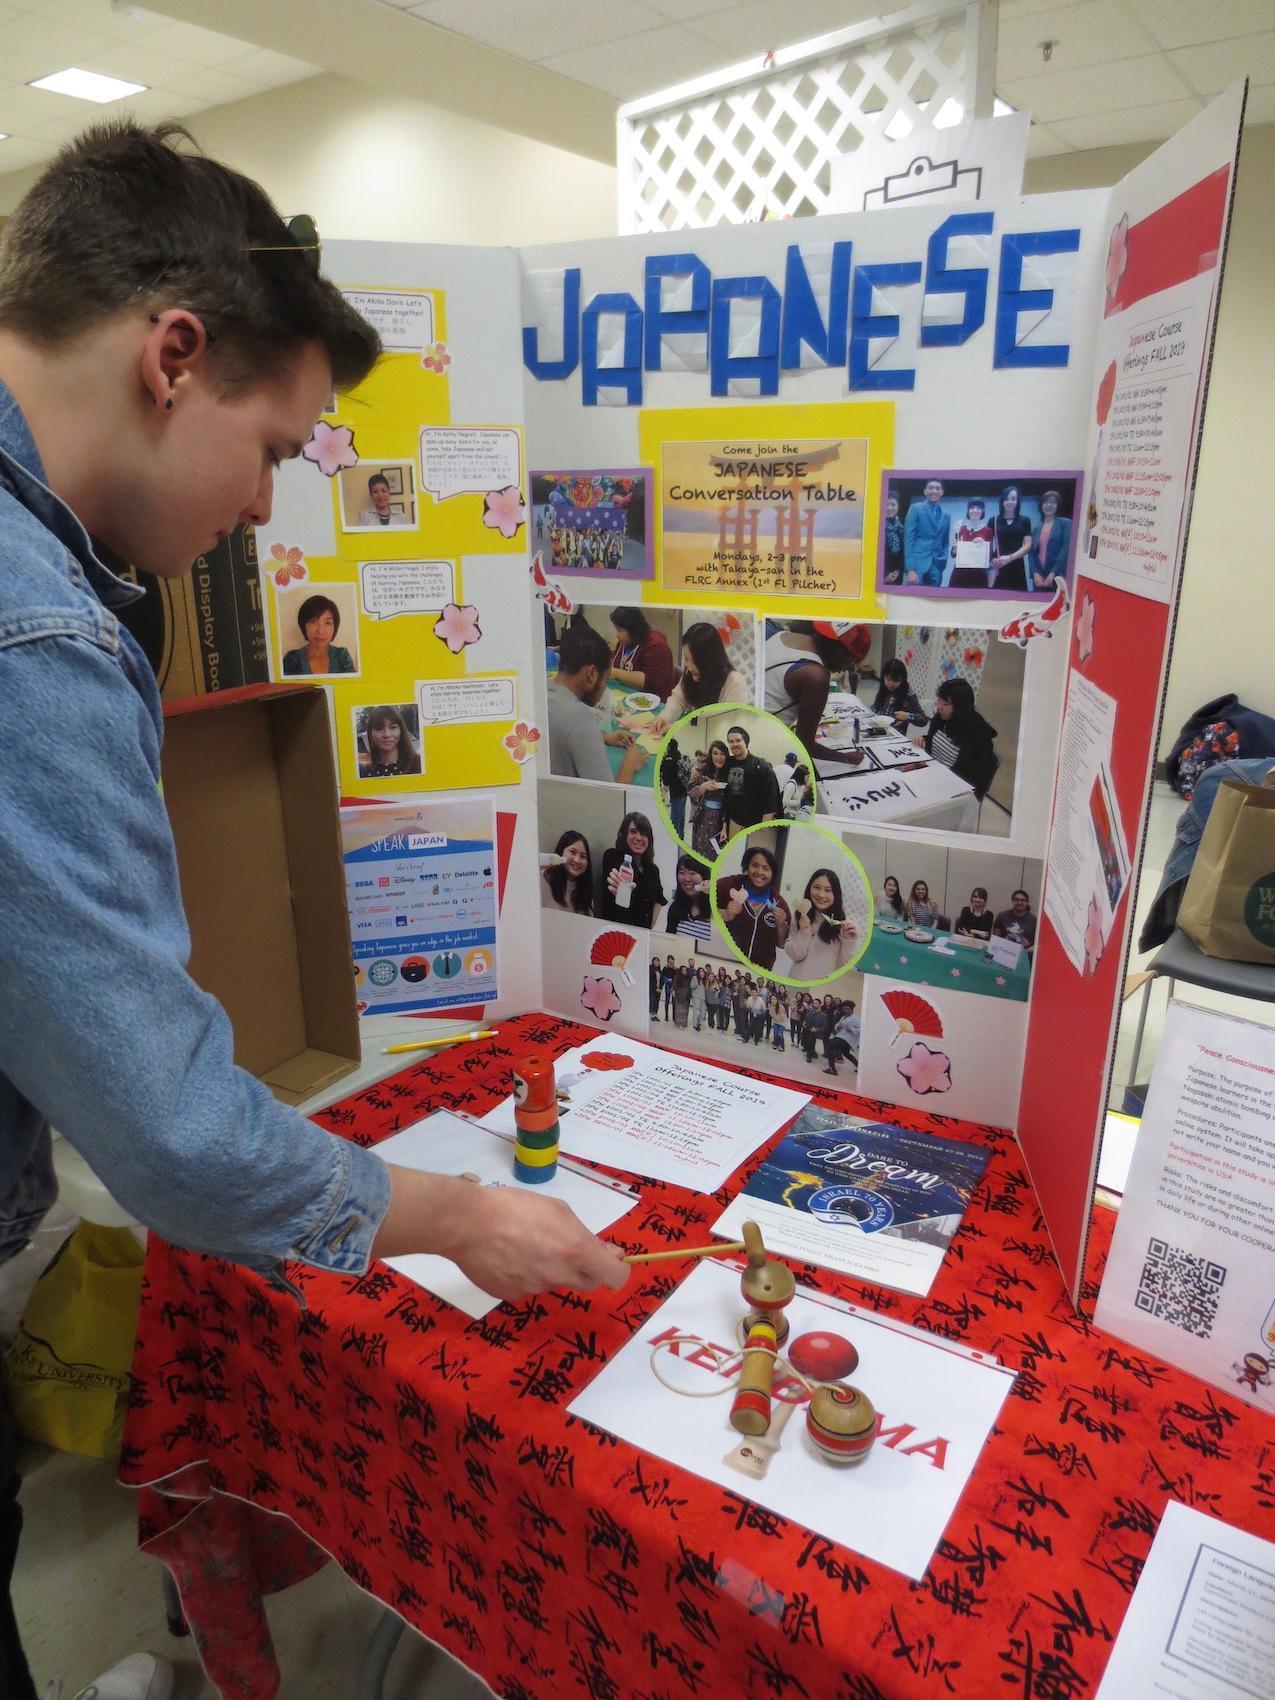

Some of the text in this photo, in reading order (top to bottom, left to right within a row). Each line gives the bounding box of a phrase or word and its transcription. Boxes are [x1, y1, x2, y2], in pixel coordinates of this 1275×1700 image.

[364, 308, 392, 317] Japanese
[522, 212, 1080, 406] JAPANESE
[1128, 321, 1182, 353] Japanese Course
[1150, 345, 1167, 363] FALL
[1169, 341, 1185, 358] 2019
[723, 444, 798, 457] Come join the
[714, 462, 808, 478] JAPANESE
[670, 482, 856, 502] Conversation Table
[696, 563, 824, 579] with Takaya-san in the
[713, 552, 807, 567] Mondays, 2-3 pm
[685, 574, 712, 585] FLRC
[716, 577, 748, 587] Annex
[752, 576, 770, 589] (1st
[792, 579, 837, 592] Pilcher)
[200, 574, 215, 648] Display
[371, 834, 444, 853] SPEAK JAPAN
[655, 1066, 766, 1105] Offerings FALL 2019
[671, 1064, 761, 1096] Japanese Course
[1185, 1074, 1218, 1091] Japanese
[1219, 1085, 1248, 1100] learners
[1259, 1098, 1271, 1108] the
[1219, 1074, 1232, 1084] The
[1233, 1080, 1261, 1095] purpose
[1264, 1088, 1272, 1097] of
[1180, 1094, 1209, 1110] weapons
[1182, 1084, 1270, 1121] Nagasaki atomic bombing
[1172, 1127, 1270, 1170] not write your name and you
[1174, 1117, 1194, 1130] online
[1234, 1138, 1245, 1148] will
[1248, 1143, 1263, 1154] take
[1218, 1122, 1261, 1145] Participants
[806, 1143, 944, 1190] Dream
[866, 1152, 908, 1167] DARE TO
[1166, 1151, 1214, 1174] universities in
[1167, 1141, 1267, 1184] Participation in this study is
[818, 1188, 887, 1228] ISRAEL 70 YEARS
[1168, 1177, 1182, 1189] this
[1183, 1184, 1203, 1198] study
[1204, 1192, 1216, 1202] are
[1217, 1197, 1226, 1206] no
[1227, 1201, 1255, 1219] greater
[1258, 1211, 1274, 1226] than
[1186, 1173, 1198, 1184] The
[1199, 1179, 1217, 1192] risks
[1218, 1186, 1231, 1197] and
[1232, 1192, 1272, 1214] discomfort
[1154, 1199, 1182, 1216] THANK
[1182, 1209, 1199, 1223] YOU
[1200, 1216, 1216, 1229] FOR
[1218, 1223, 1239, 1239] YOUR
[1166, 1187, 1182, 1200] daily
[1183, 1194, 1196, 1205] life
[1206, 1203, 1229, 1221] during
[1230, 1212, 1251, 1227] other
[1252, 1220, 1274, 1237] online
[38, 1365, 126, 1390] UNIVERSITY
